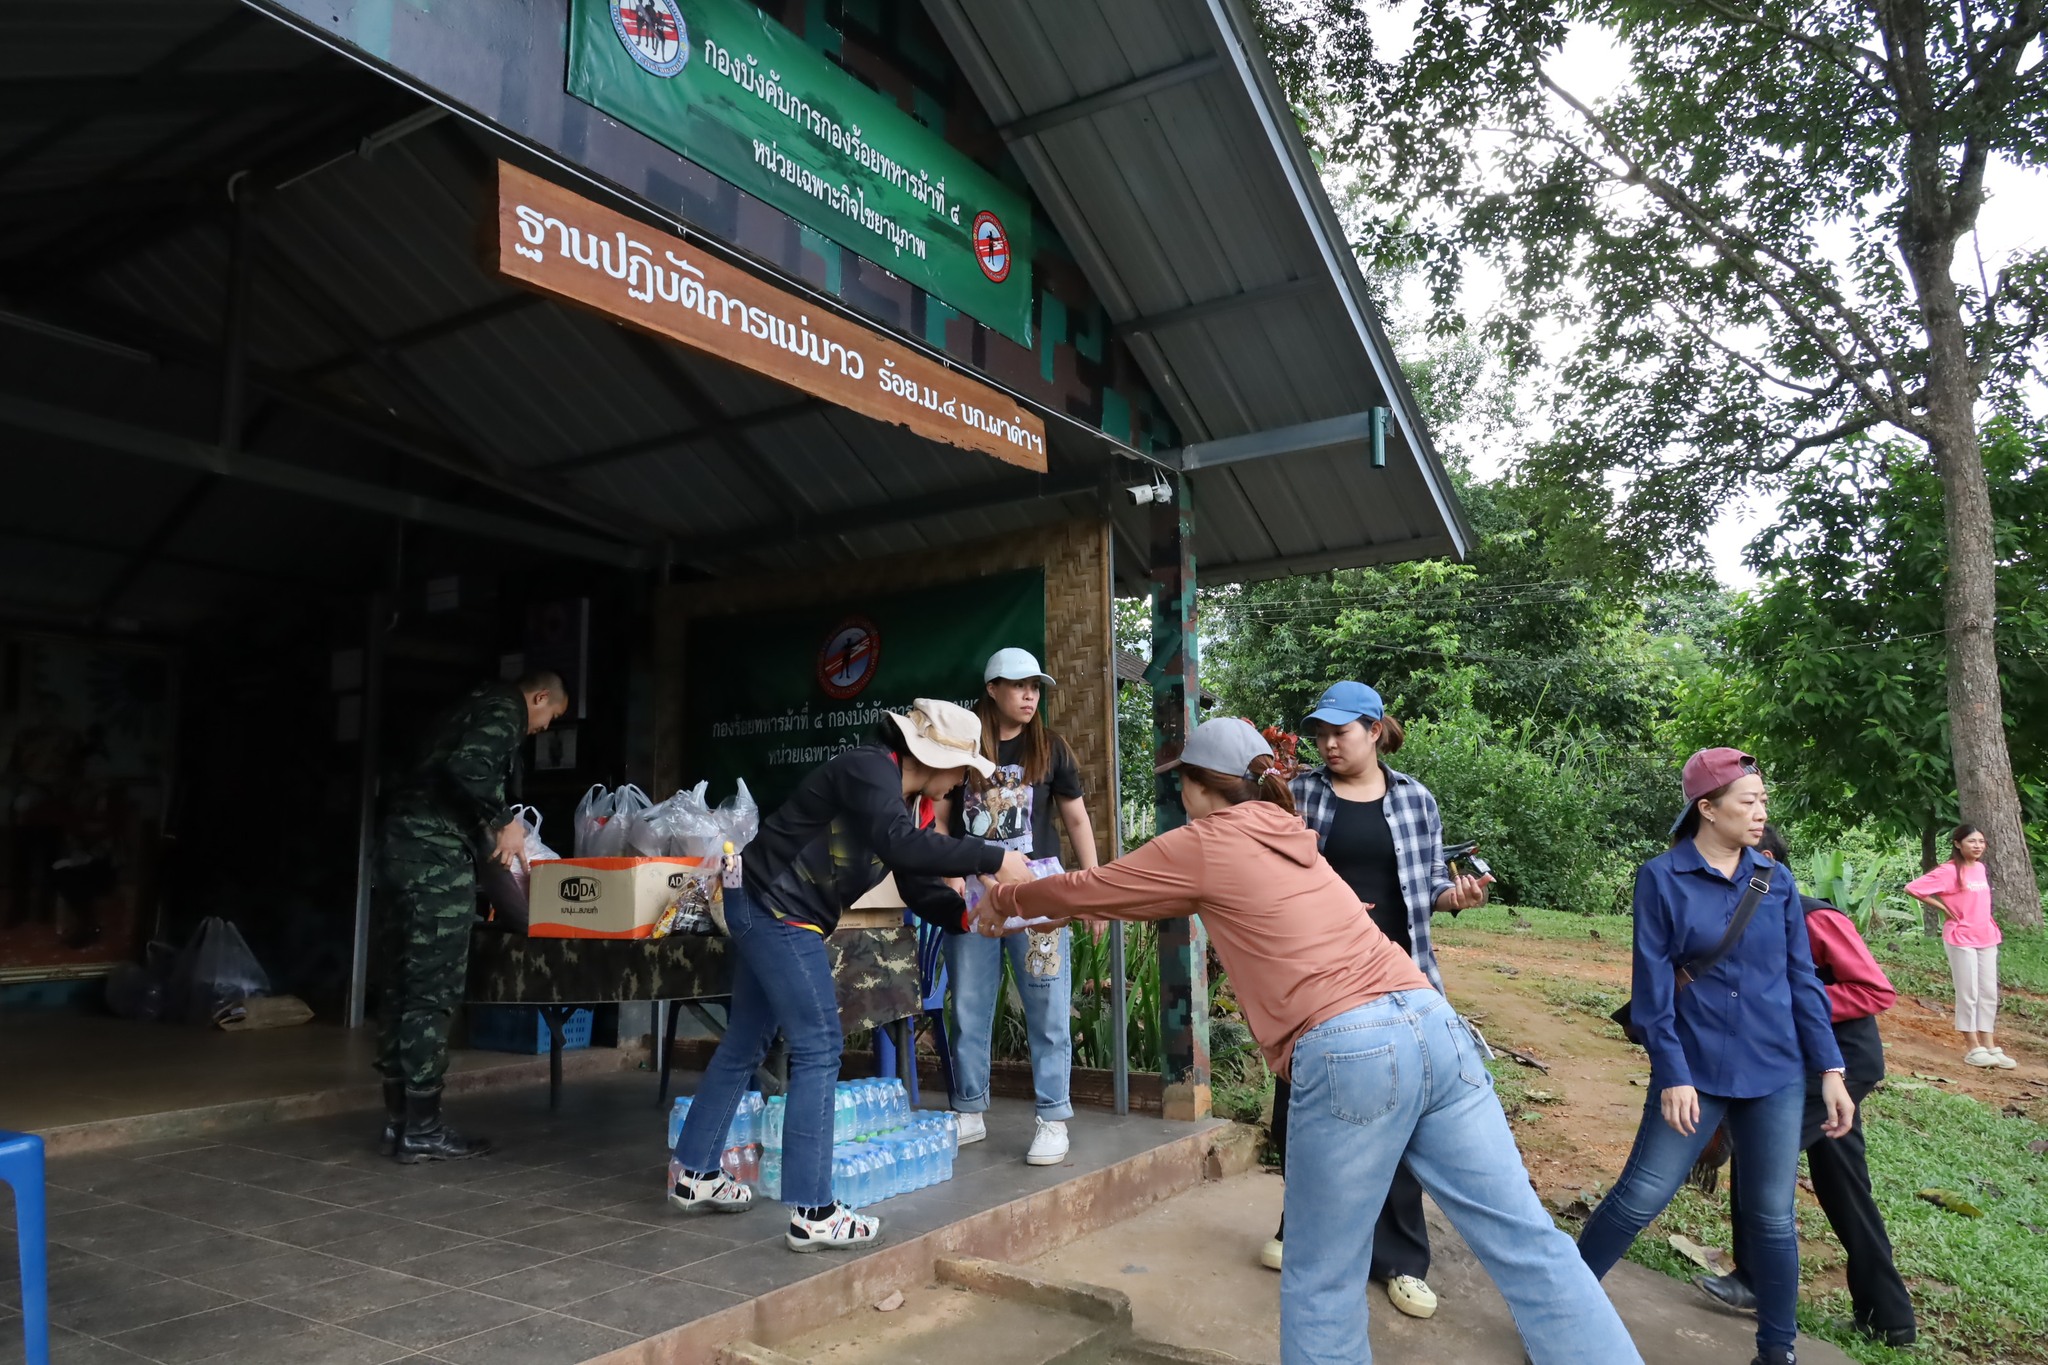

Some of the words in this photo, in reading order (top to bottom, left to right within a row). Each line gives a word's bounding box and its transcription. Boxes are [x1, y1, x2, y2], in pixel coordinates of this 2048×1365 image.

[704, 39, 945, 216] กองบังคับการกองร้อยทหารม้าที่
[950, 204, 960, 226] ๔
[753, 138, 926, 260] หน่วยเฉพาะกิจไชยานุภาพ
[515, 204, 864, 380] ฐานปฏิบัติการแม่มาว
[878, 358, 957, 419] ร้อย.ม.๔
[712, 701, 808, 738] กองร้อยทหารม้าที่
[813, 712, 823, 729] ๔
[562, 882, 597, 897] ADDA
